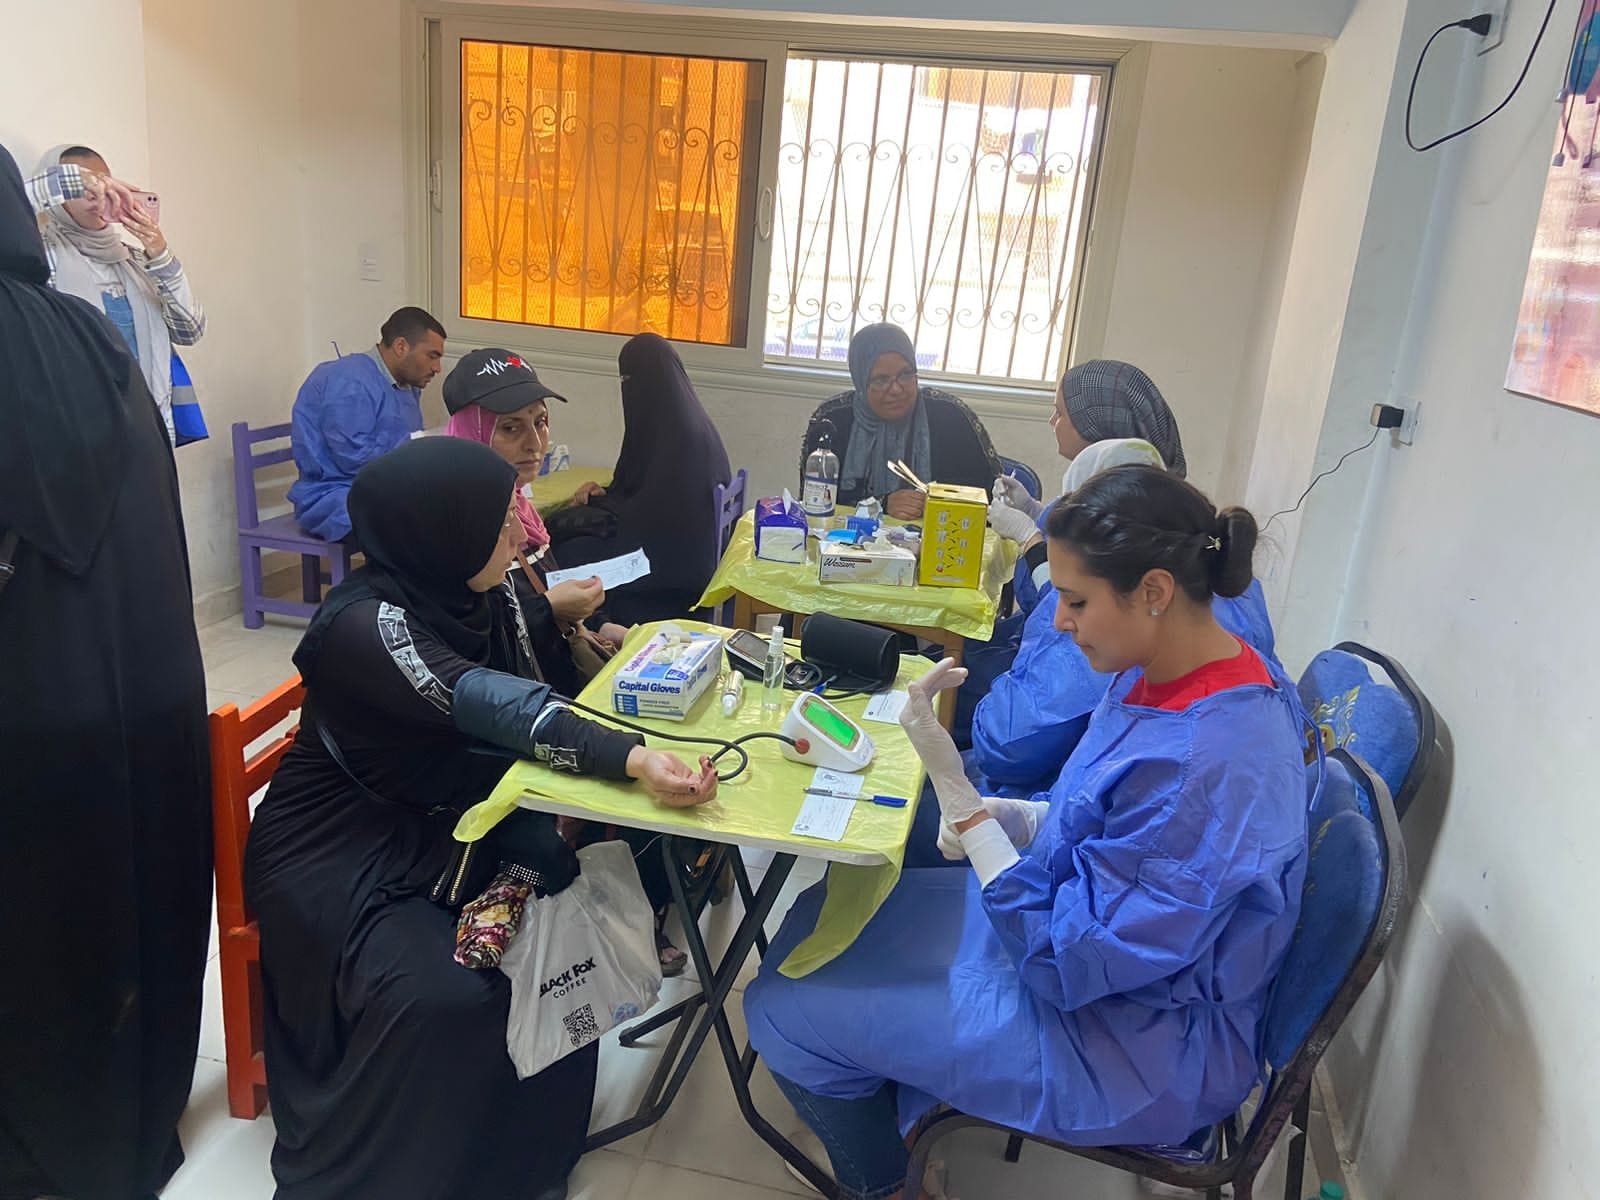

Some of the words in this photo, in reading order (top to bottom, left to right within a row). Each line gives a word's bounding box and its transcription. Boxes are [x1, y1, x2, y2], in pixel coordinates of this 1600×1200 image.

[619, 680, 649, 692] Capital
[650, 683, 680, 694] Gloves
[553, 978, 586, 998] COFFEE
